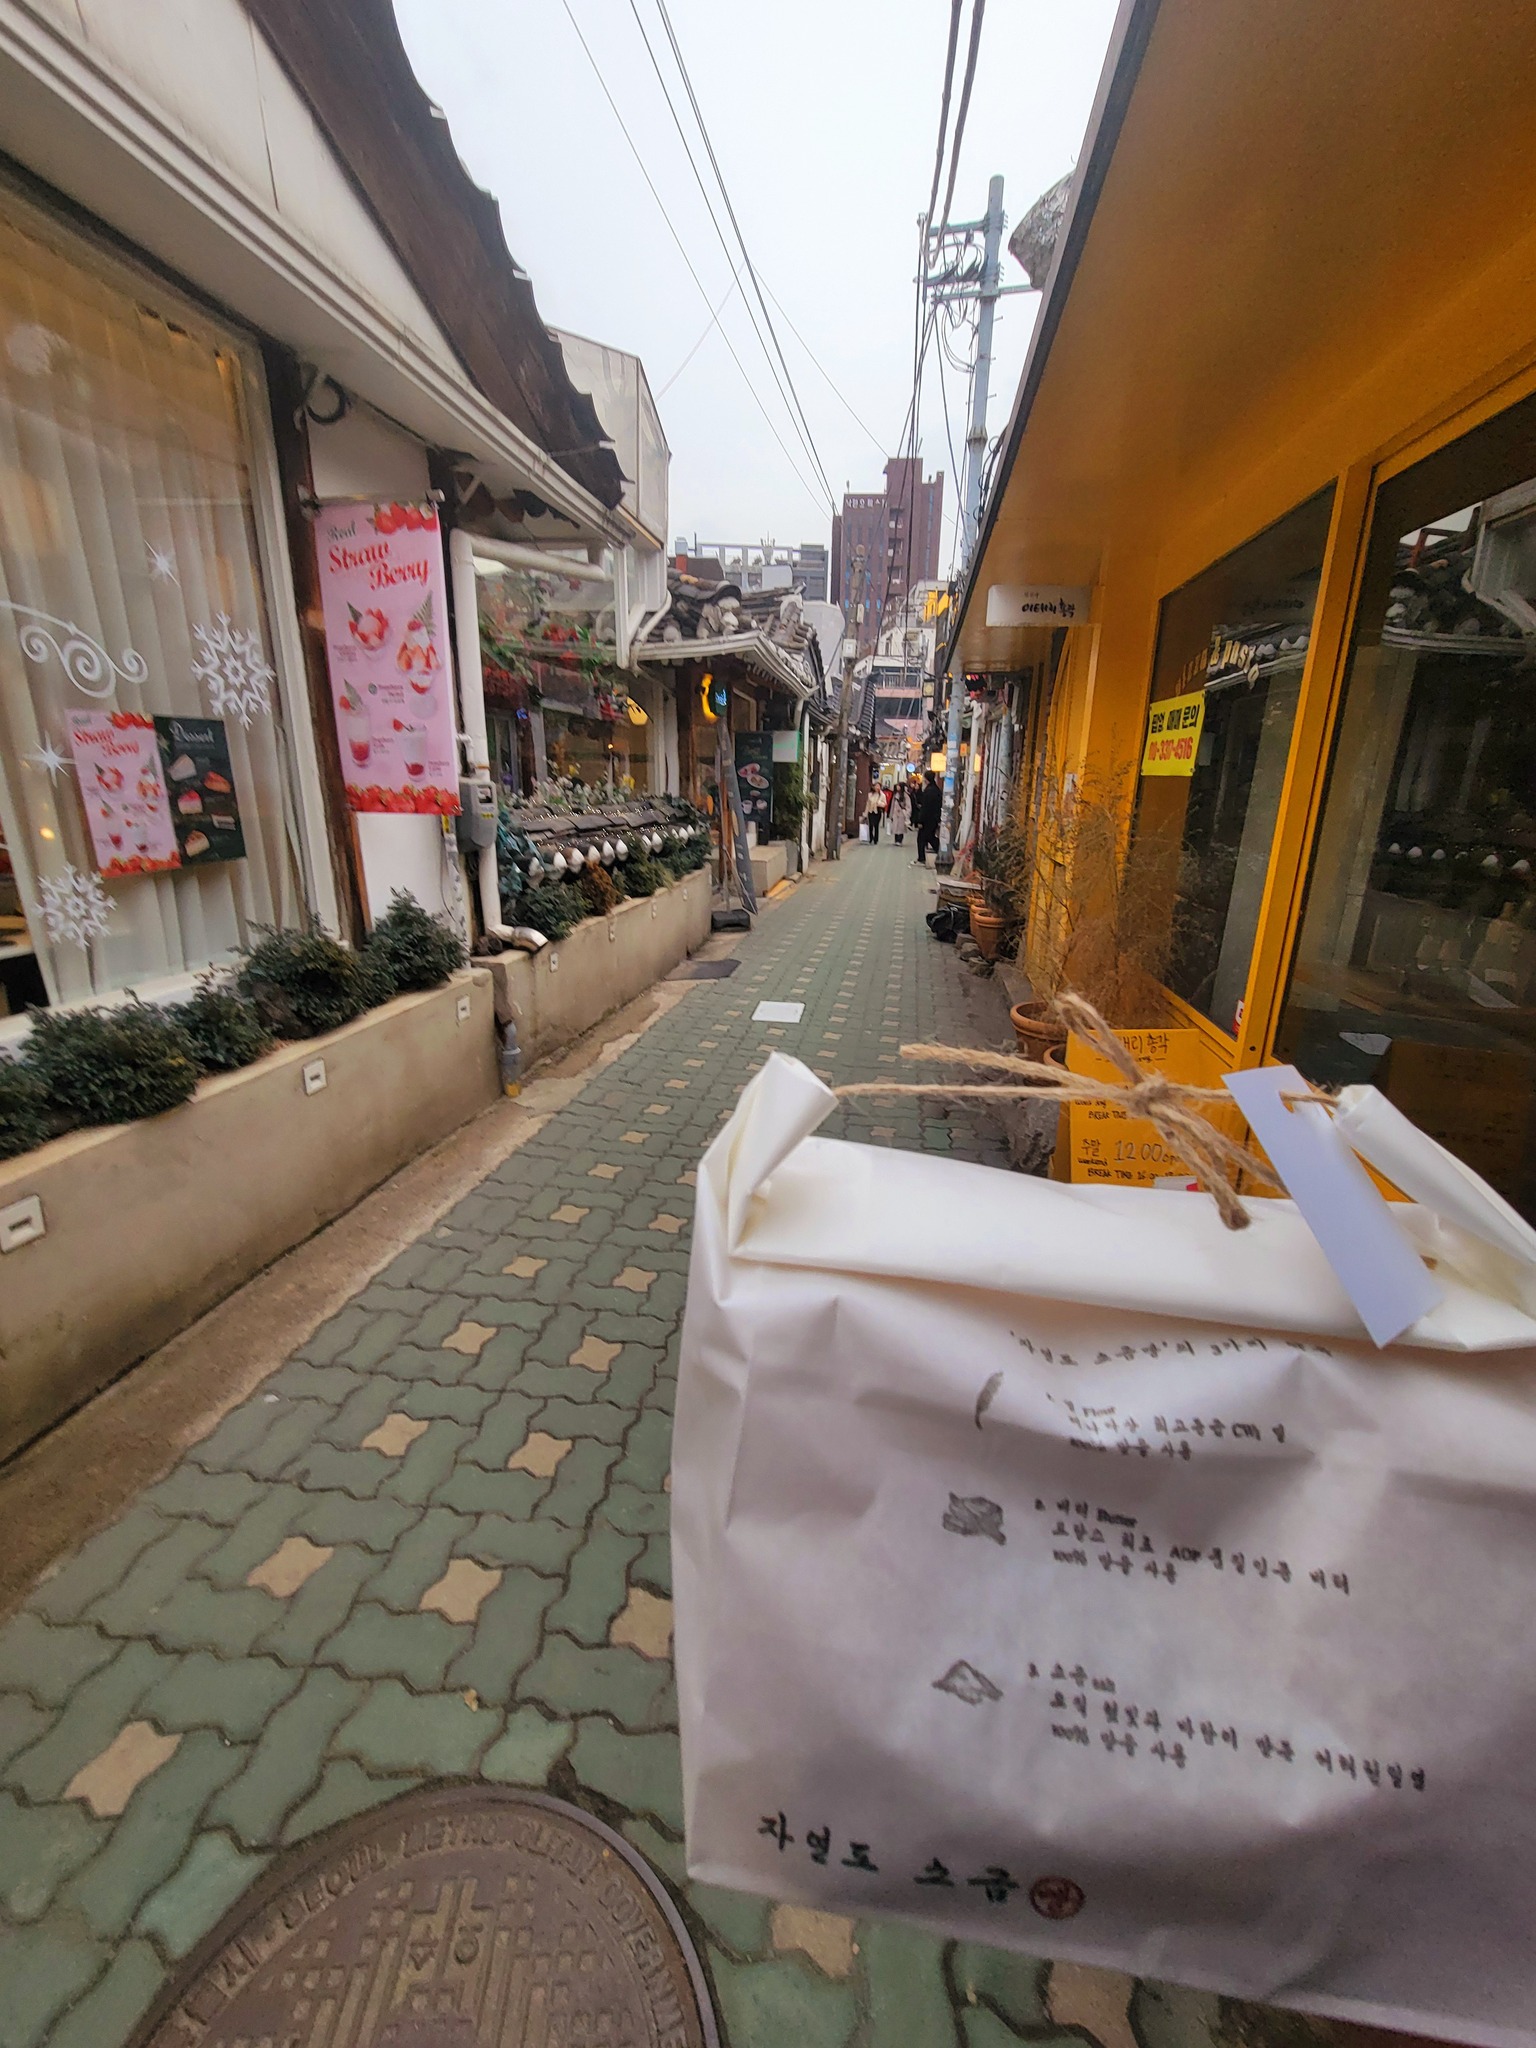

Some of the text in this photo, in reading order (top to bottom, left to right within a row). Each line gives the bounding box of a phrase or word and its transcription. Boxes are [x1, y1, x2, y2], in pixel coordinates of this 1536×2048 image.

[326, 519, 358, 542] Real
[328, 540, 391, 576] Straw
[369, 558, 431, 592] Berry
[1182, 704, 1200, 729] 문의
[1081, 1138, 1102, 1157] 주말
[912, 1856, 1020, 1904] 소금
